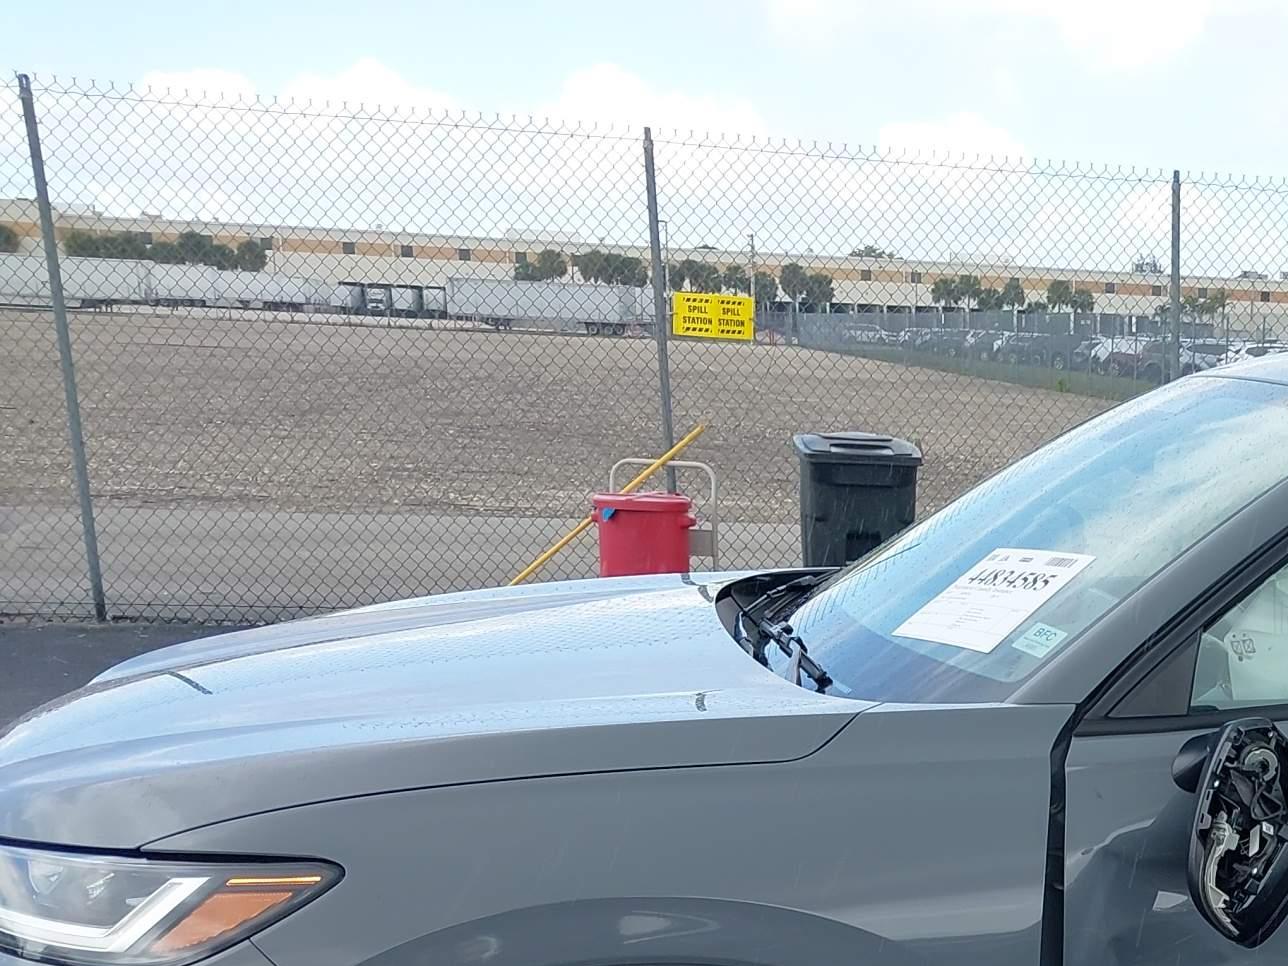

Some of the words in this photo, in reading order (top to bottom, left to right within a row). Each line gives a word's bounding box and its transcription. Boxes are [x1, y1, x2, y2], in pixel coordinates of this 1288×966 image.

[688, 305, 708, 314] SPILL
[722, 307, 741, 316] SPILL
[682, 316, 713, 325] STATION
[718, 318, 745, 327] STATION
[968, 569, 1058, 591] 44834585
[1033, 627, 1057, 641] BFC
